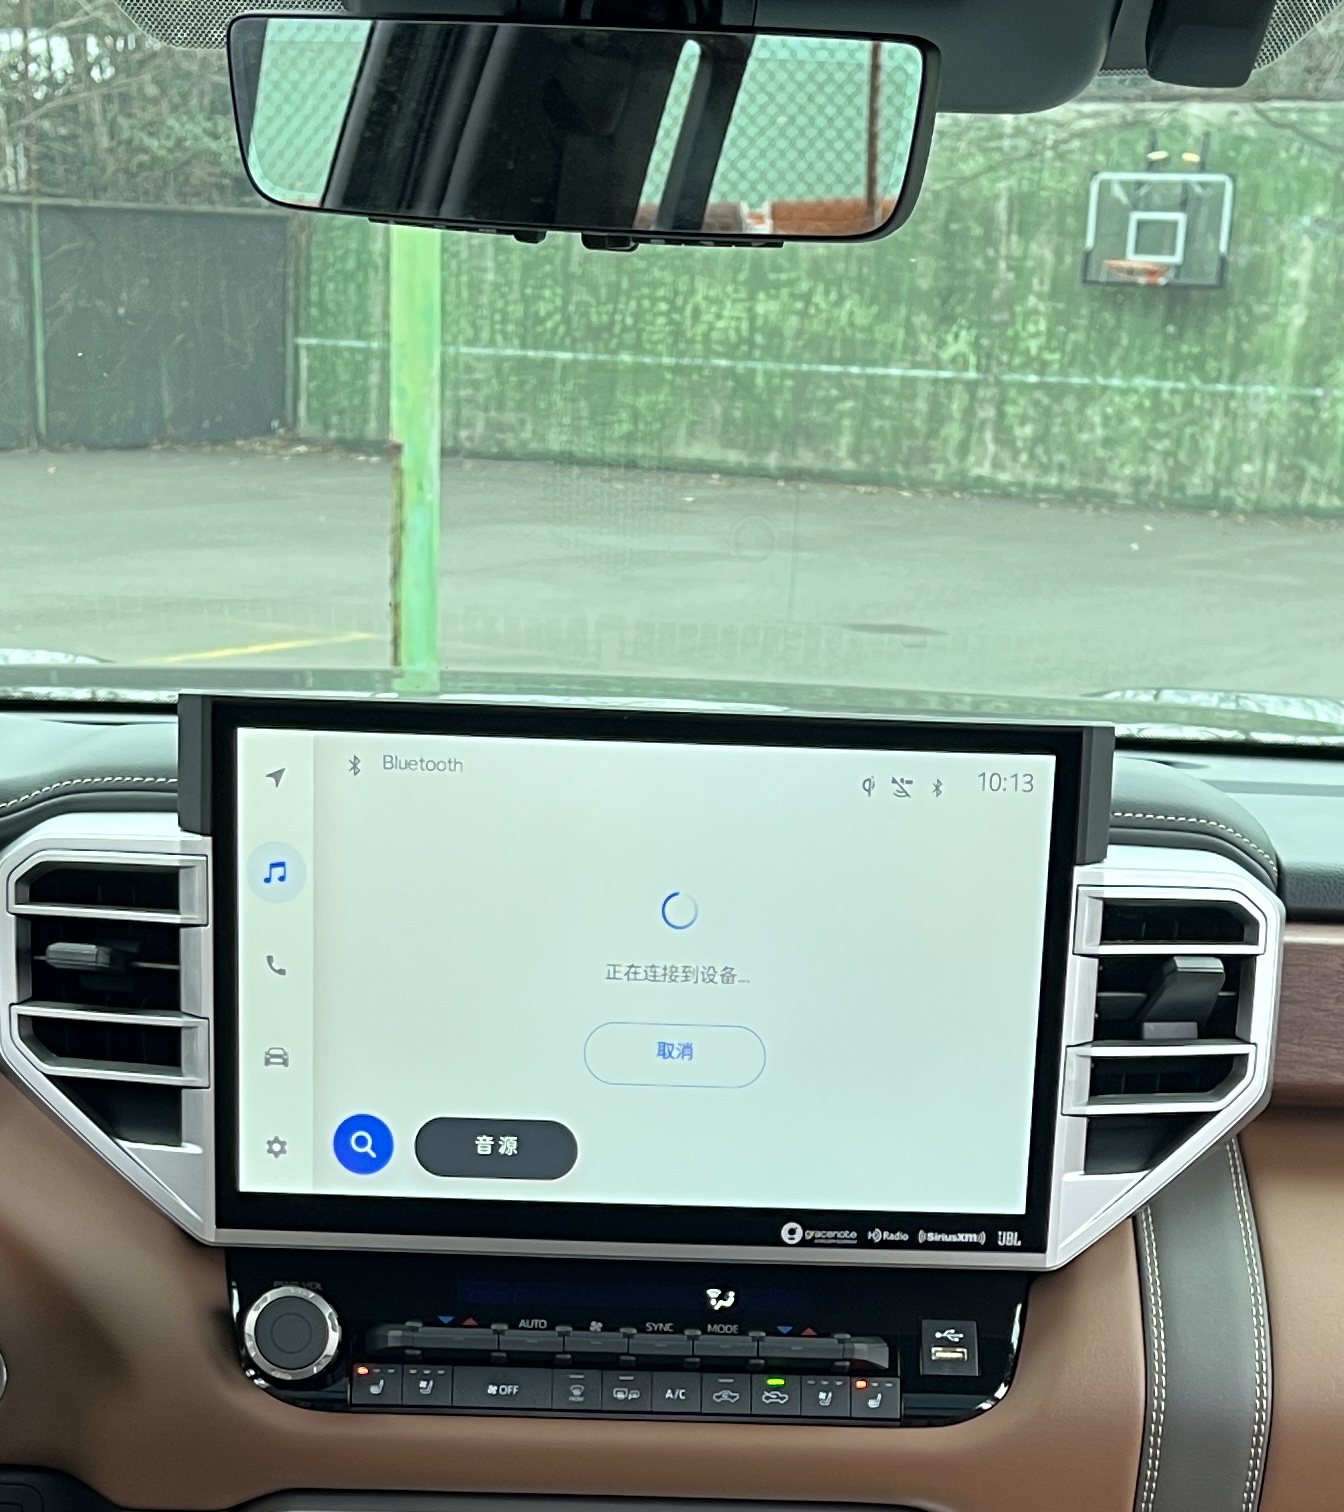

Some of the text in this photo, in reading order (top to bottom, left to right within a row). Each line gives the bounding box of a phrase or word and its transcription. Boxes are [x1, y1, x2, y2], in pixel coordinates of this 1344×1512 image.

[382, 754, 464, 772] Bluetooth
[977, 771, 1034, 793] 10:13
[656, 1041, 694, 1061] 取消
[475, 1134, 518, 1156] 音源
[883, 1230, 910, 1241] Radio
[997, 1230, 1022, 1246] JBL
[518, 1319, 548, 1329] AUTO
[645, 1322, 674, 1333] SYNC
[707, 1324, 739, 1334] MODE
[498, 1384, 519, 1395] OFF
[665, 1389, 686, 1399] A/C
